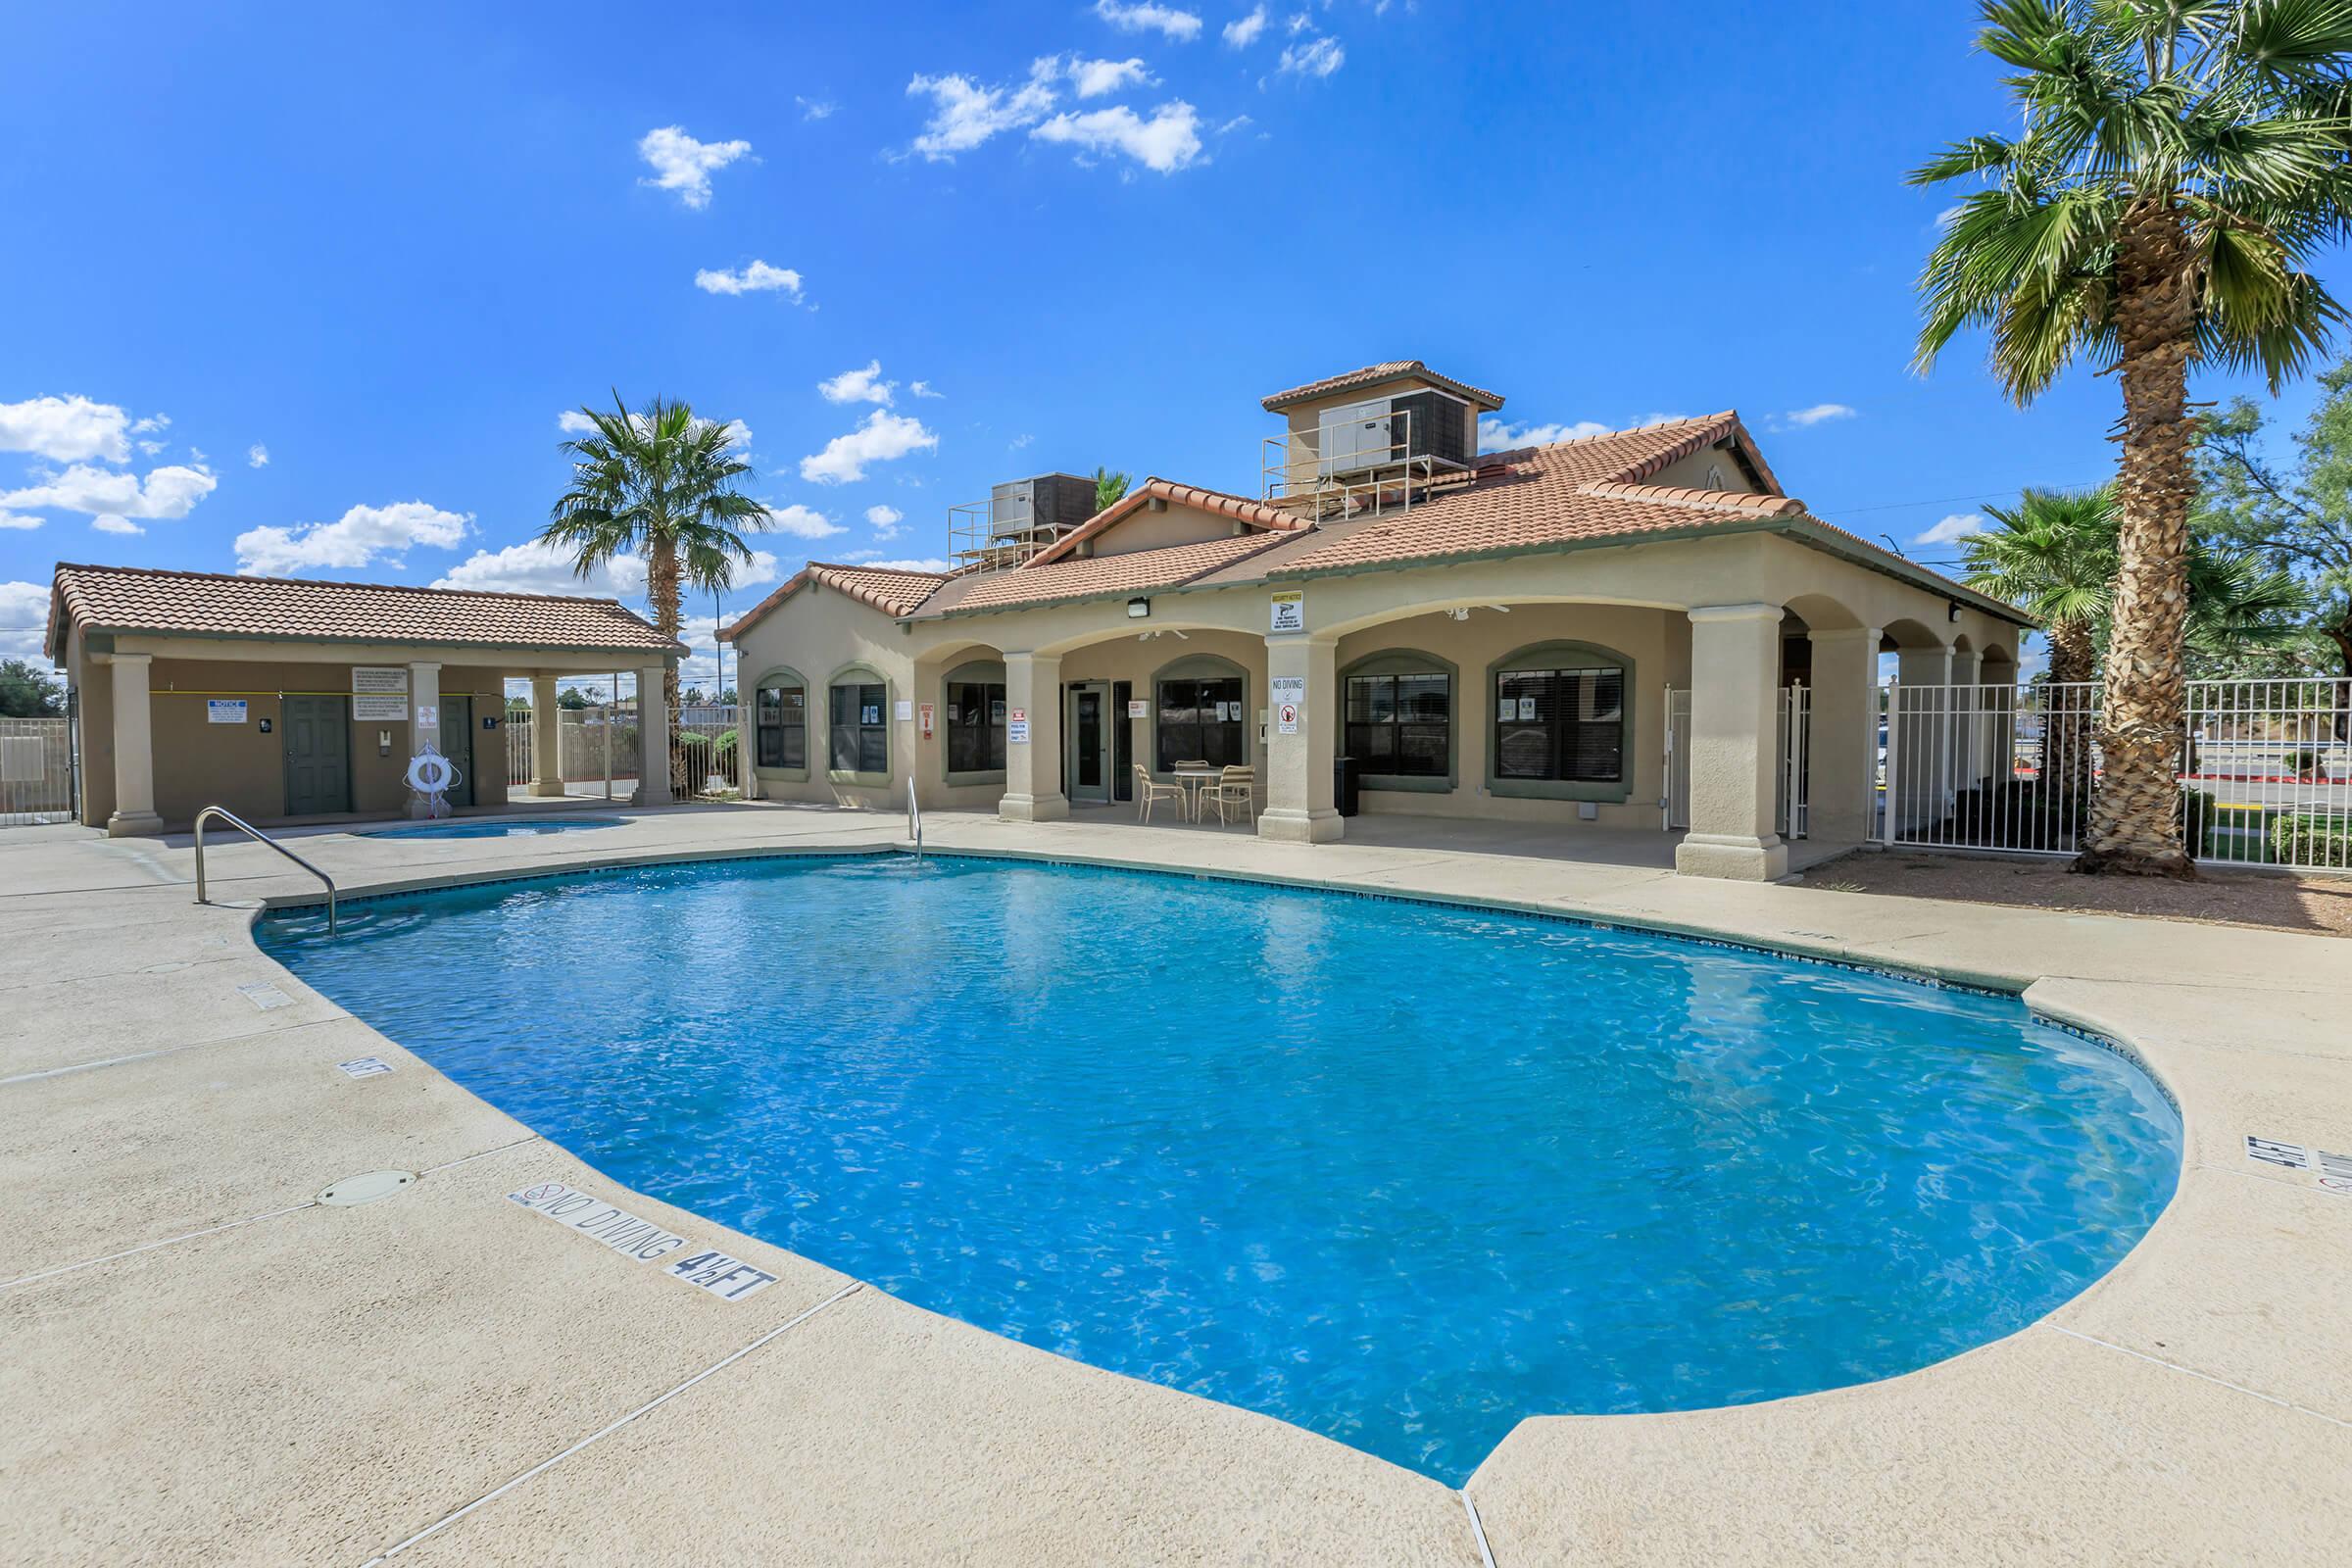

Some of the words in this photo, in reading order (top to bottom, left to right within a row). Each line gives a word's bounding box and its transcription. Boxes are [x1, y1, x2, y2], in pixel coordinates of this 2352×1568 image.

[1273, 680, 1282, 690] NO
[1283, 679, 1302, 690] DIVING
[536, 1192, 593, 1215] NO
[575, 1209, 683, 1259] DIVING
